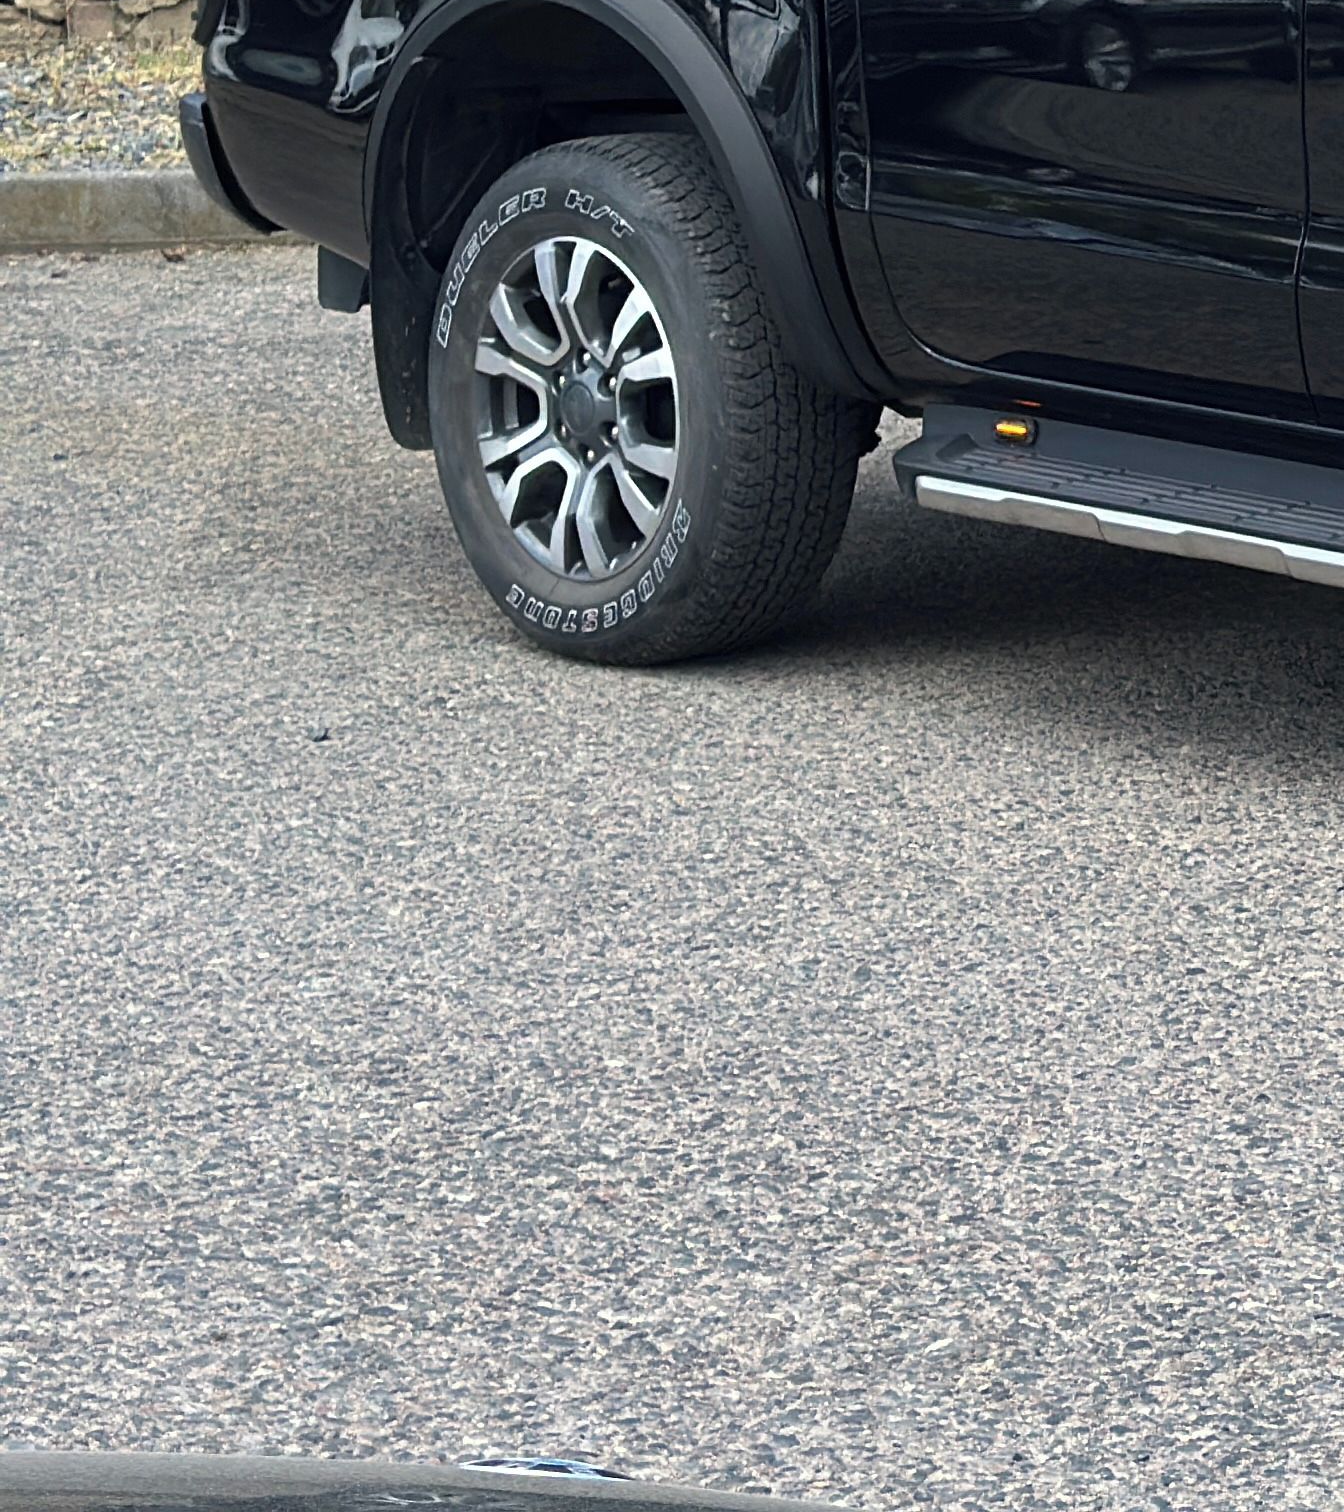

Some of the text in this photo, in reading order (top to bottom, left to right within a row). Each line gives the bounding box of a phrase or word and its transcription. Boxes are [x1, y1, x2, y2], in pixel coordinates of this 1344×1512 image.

[436, 187, 636, 349] DUELER H/T
[505, 497, 692, 633] BRIDGESTONE
